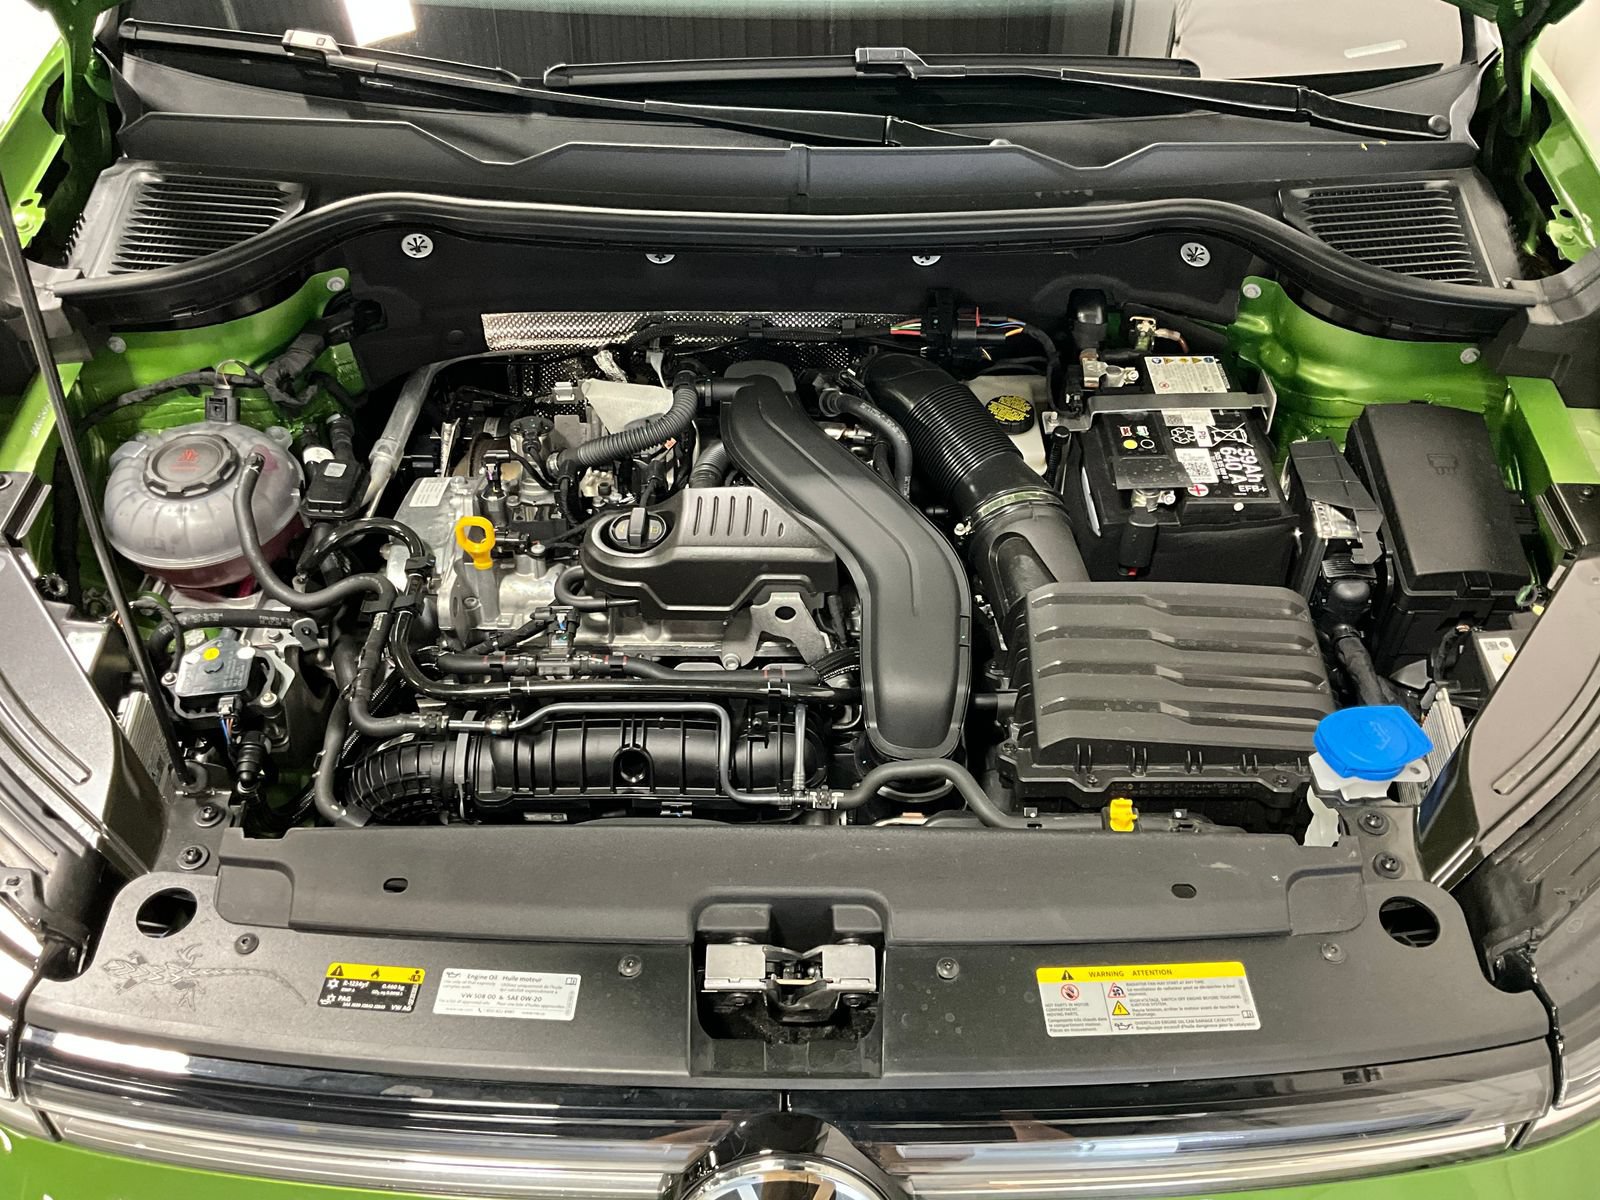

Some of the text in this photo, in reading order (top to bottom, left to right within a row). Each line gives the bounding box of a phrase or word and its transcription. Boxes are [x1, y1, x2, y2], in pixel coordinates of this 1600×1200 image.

[1220, 447, 1242, 470] 640
[1238, 448, 1264, 482] 59Ah
[342, 980, 370, 989] R-1234yf
